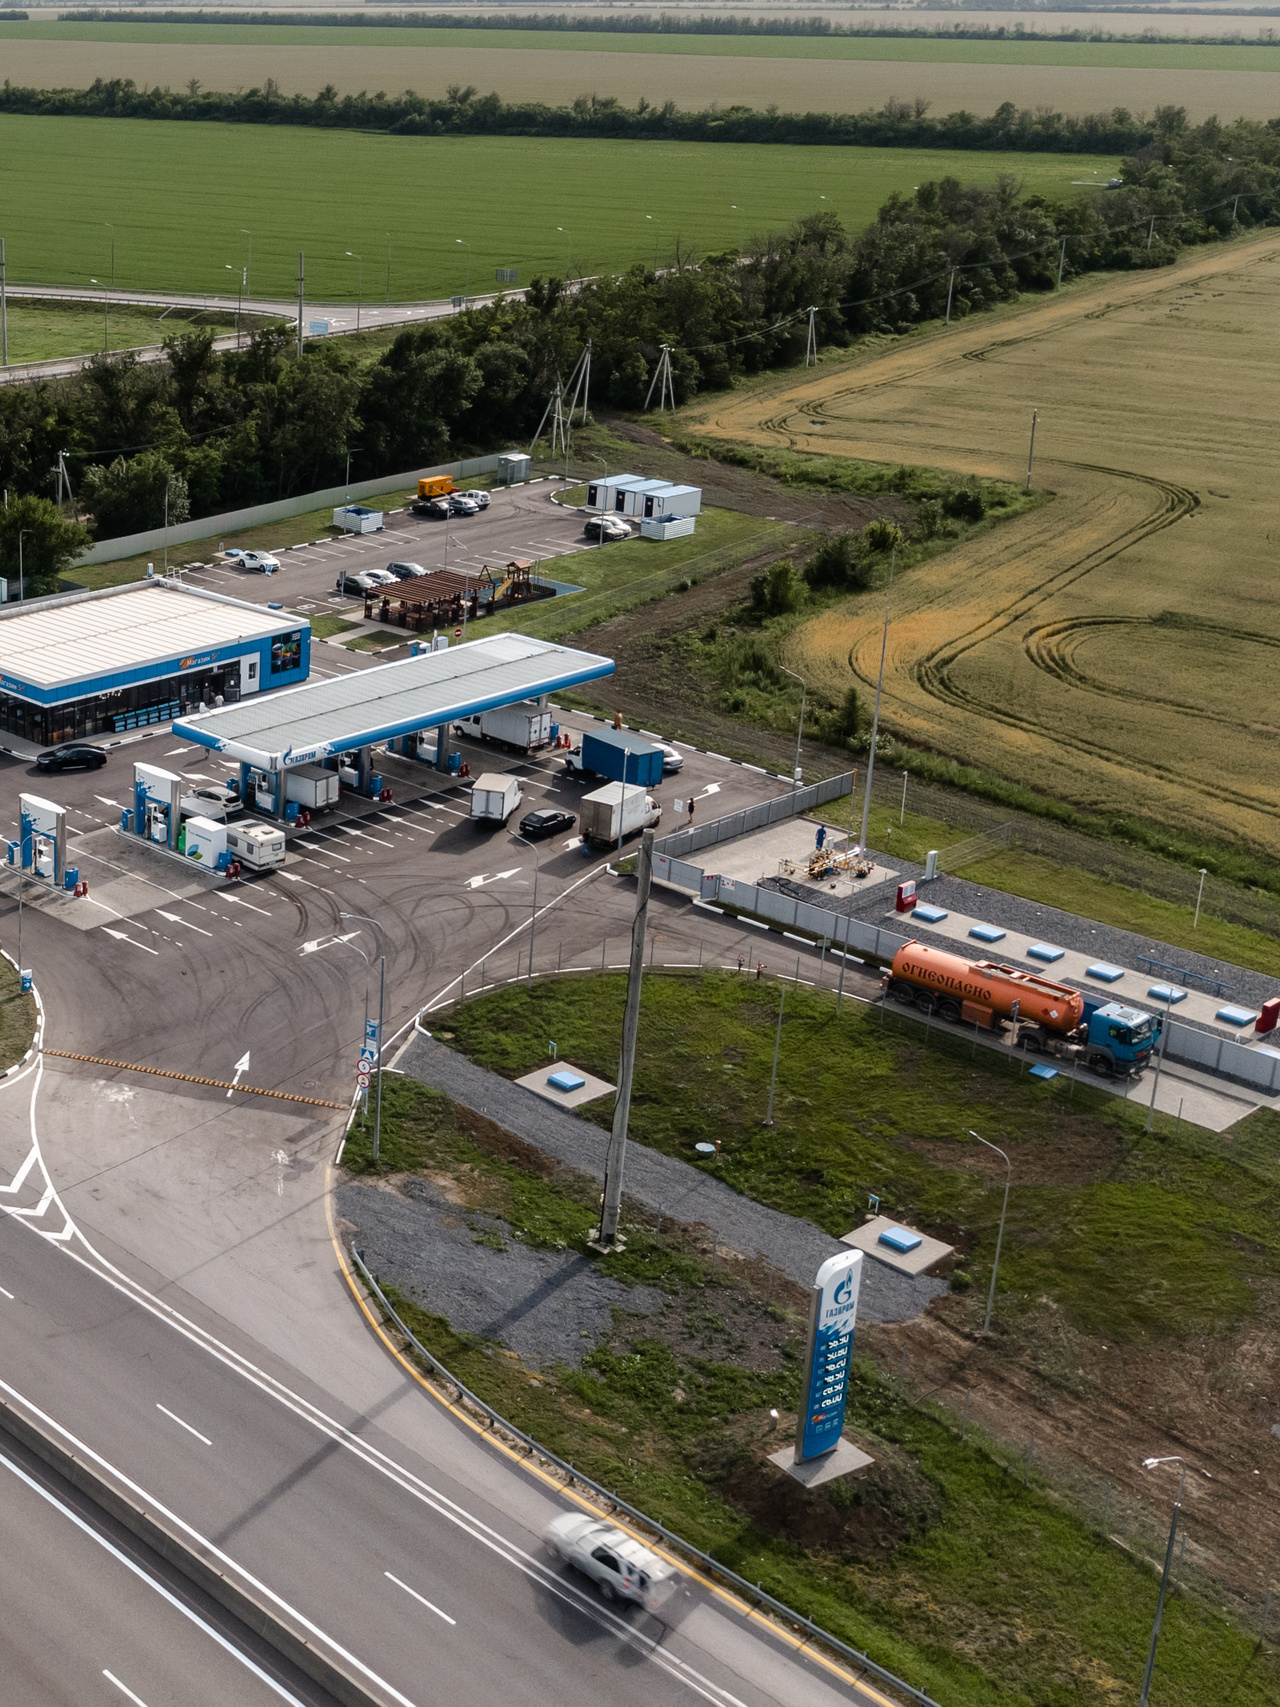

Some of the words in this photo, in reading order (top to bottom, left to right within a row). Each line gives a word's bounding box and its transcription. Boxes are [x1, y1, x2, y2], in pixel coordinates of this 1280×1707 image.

[292, 750, 317, 764] ГАЗПРОМ
[901, 962, 992, 1000] ОГНЕОПАСНО
[825, 1301, 856, 1319] ГАЗПРОМ
